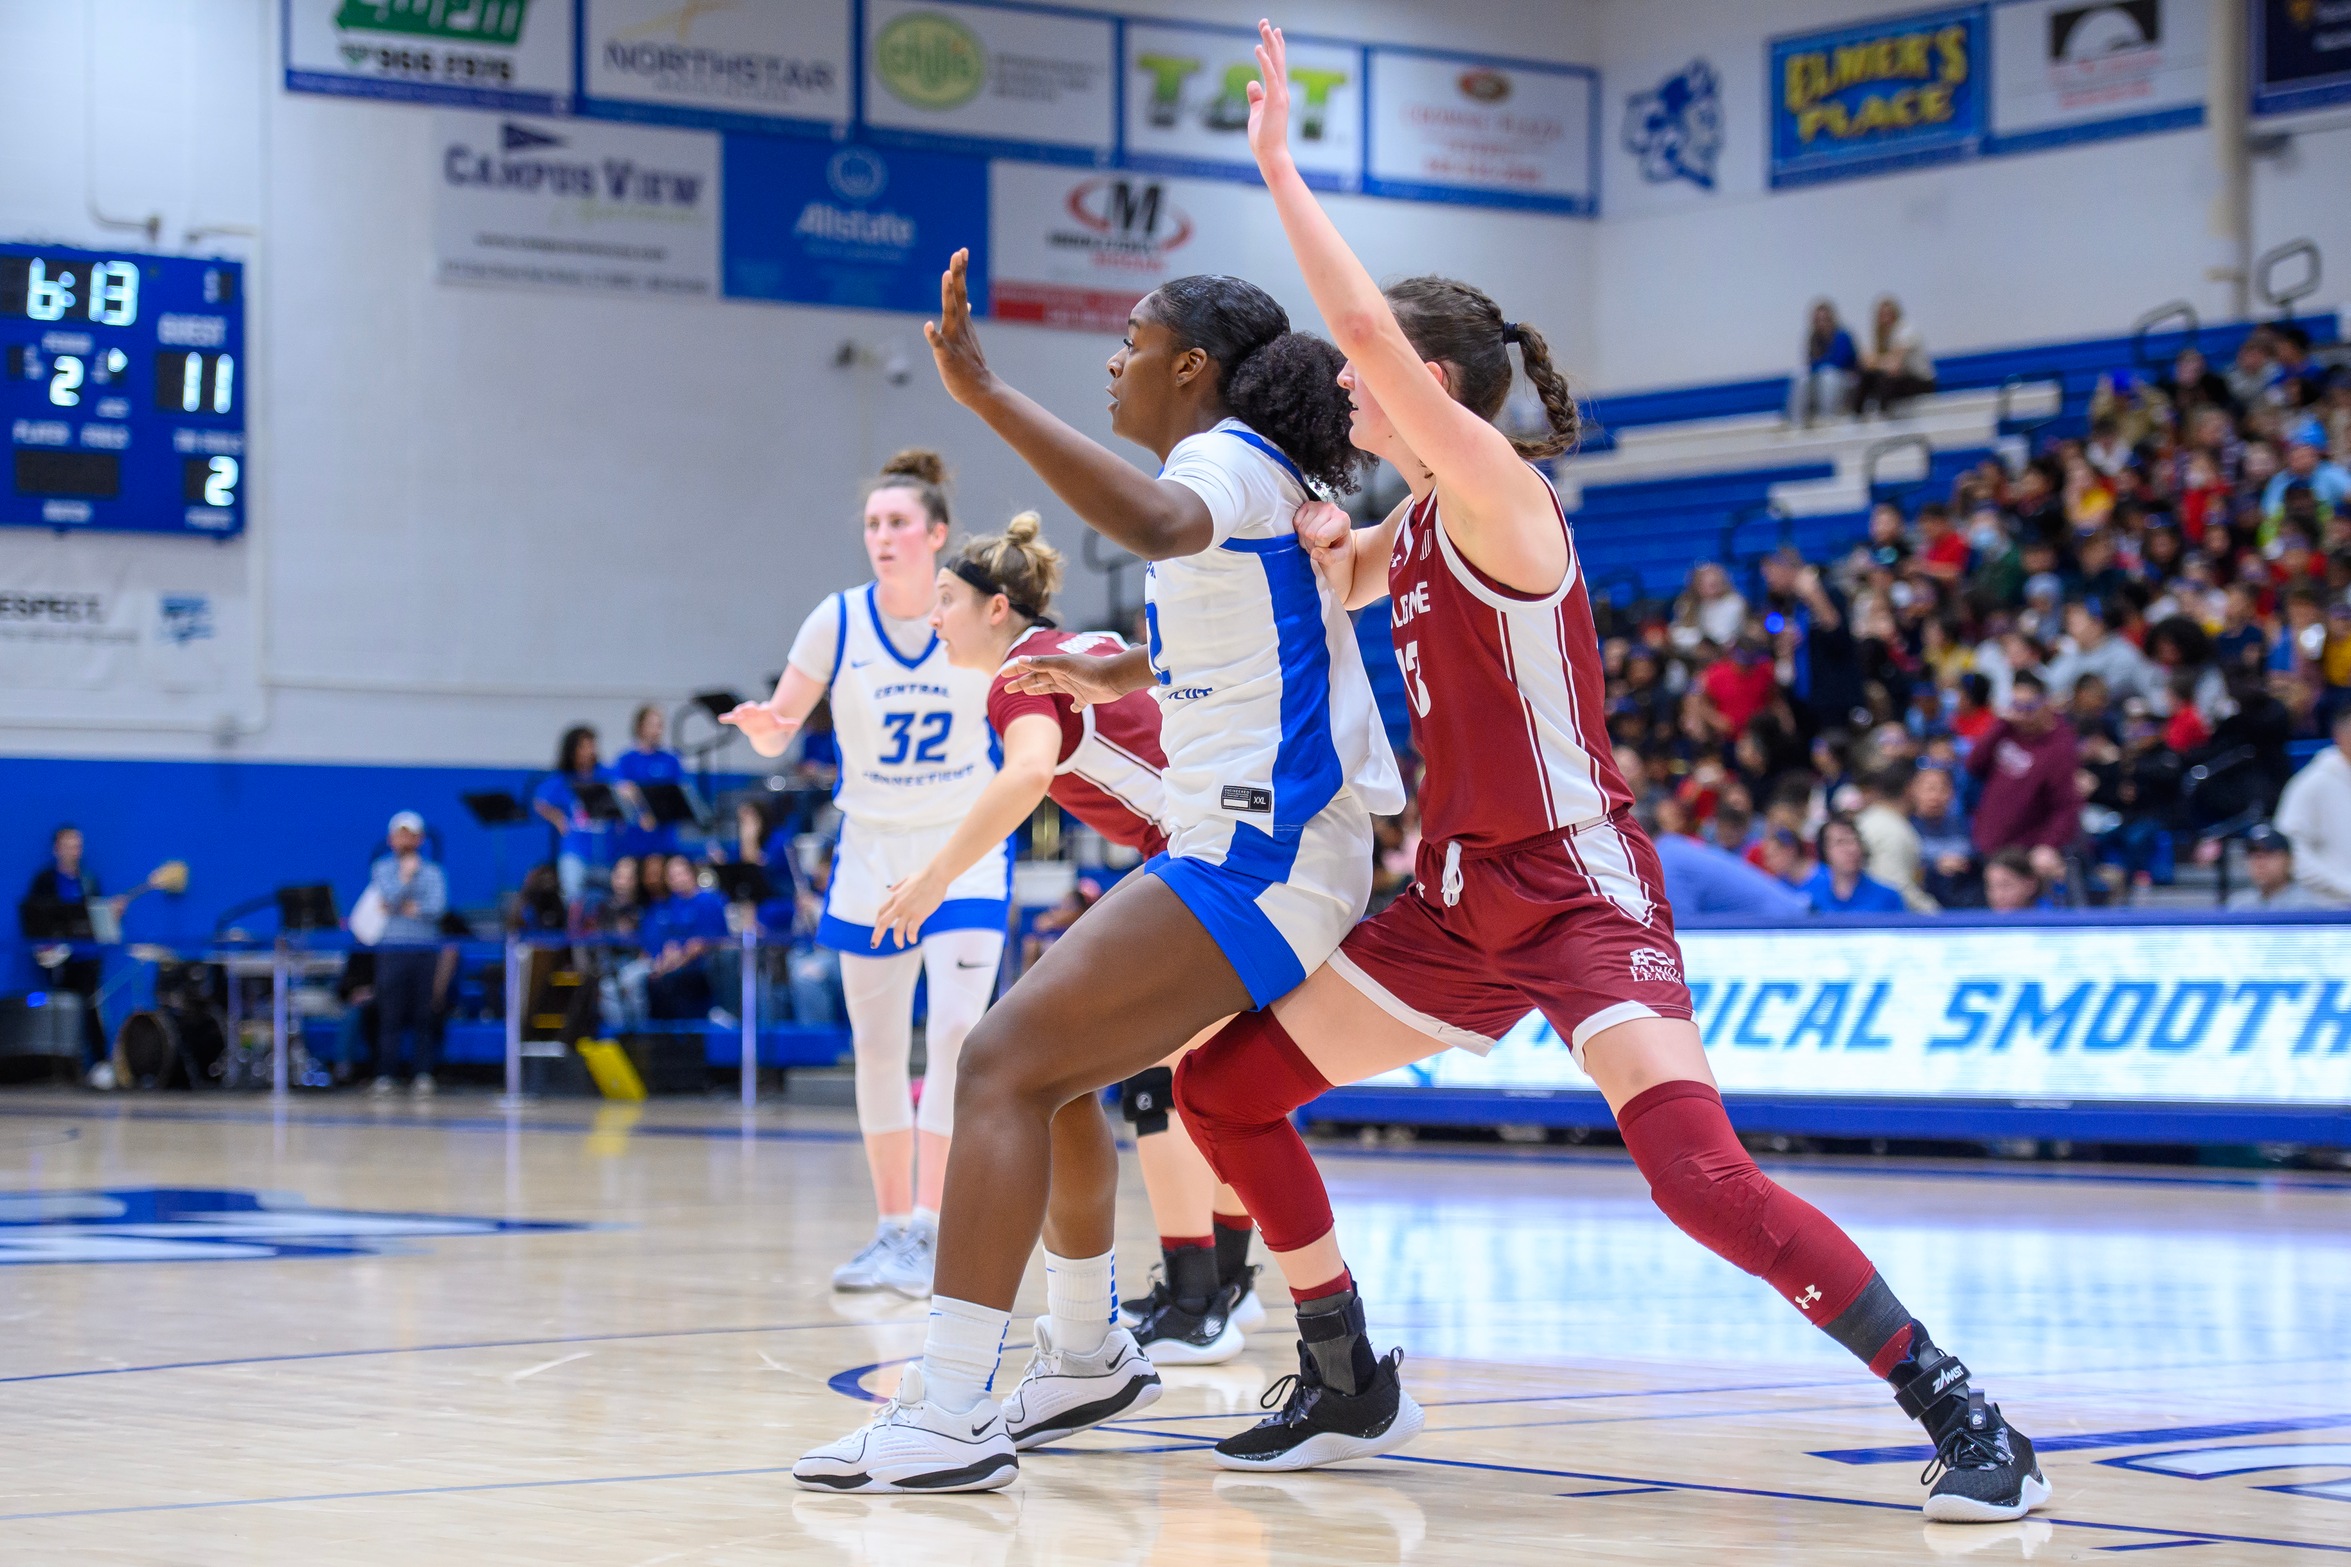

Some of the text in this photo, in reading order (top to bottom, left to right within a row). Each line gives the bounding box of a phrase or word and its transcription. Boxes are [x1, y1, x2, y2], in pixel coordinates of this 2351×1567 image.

[606, 40, 838, 94] NORTHSTAR
[1785, 25, 1968, 113] ELMER'S
[1799, 83, 1954, 143] PLACE
[444, 145, 706, 207] CAMPUS VIEW
[794, 202, 917, 250] Allstate
[26, 257, 140, 326] 6:13
[50, 356, 84, 407] 2
[182, 351, 234, 414] 11
[204, 456, 239, 506] 2
[874, 683, 950, 700] CENTRAL
[879, 711, 953, 765] 32
[1253, 796, 1267, 805] XXL
[1632, 971, 1684, 986] LEAGU
[1933, 1365, 1964, 1395] ZAMST
